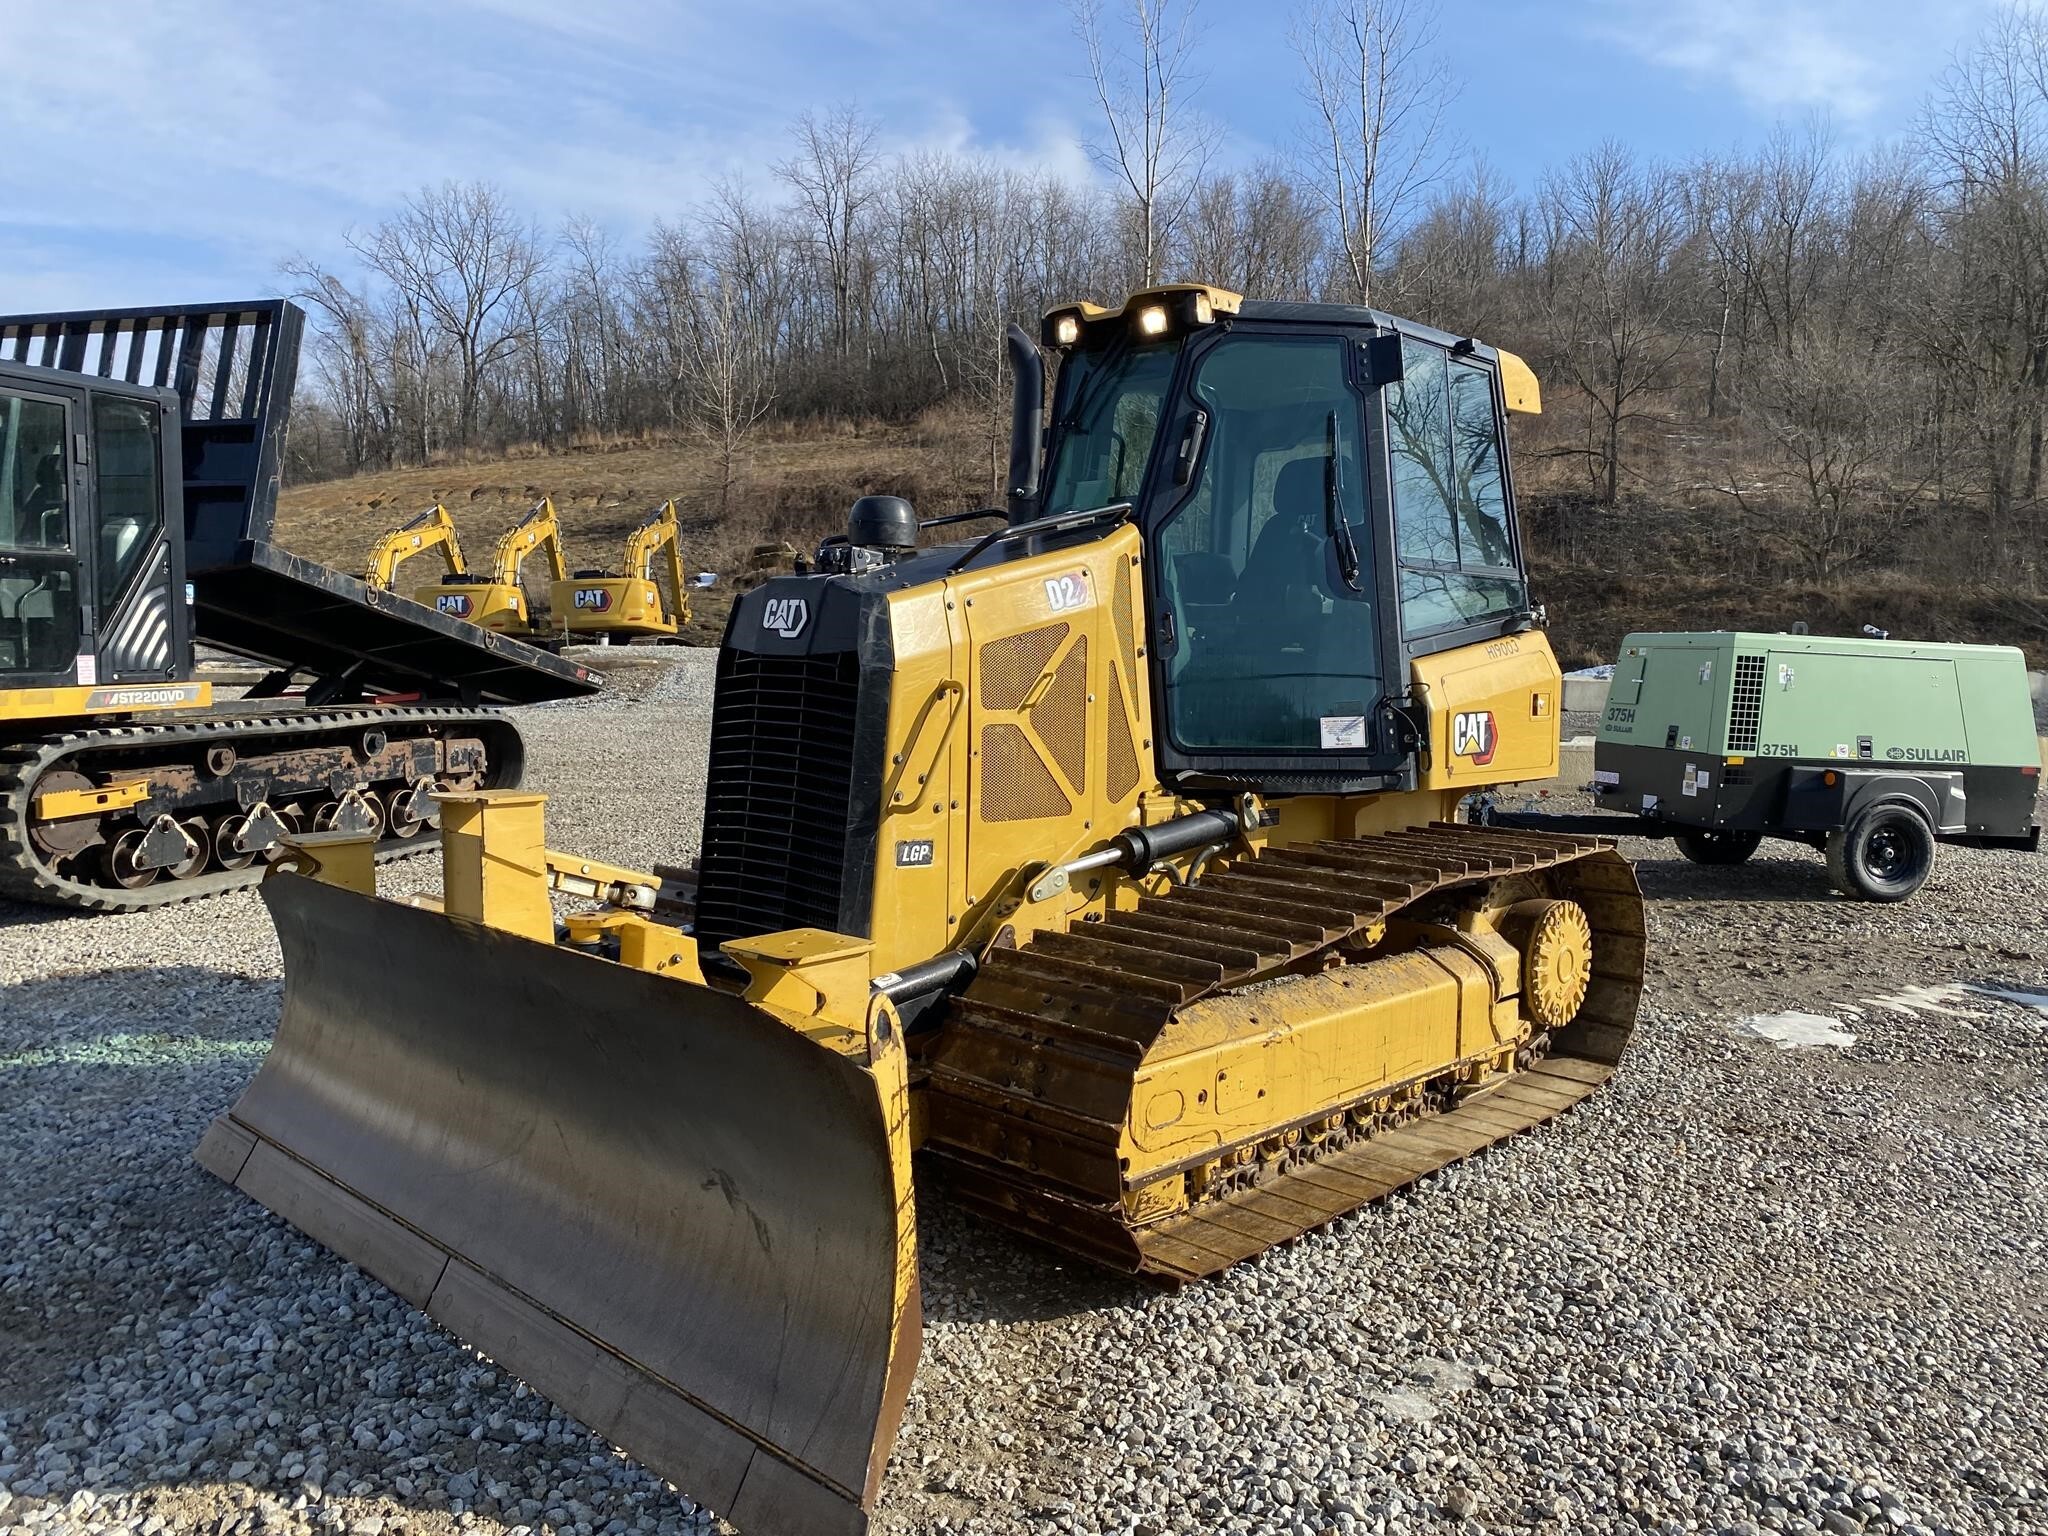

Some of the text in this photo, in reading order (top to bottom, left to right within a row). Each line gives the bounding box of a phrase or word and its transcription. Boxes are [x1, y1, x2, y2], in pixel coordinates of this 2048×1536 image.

[574, 590, 603, 608] CAT
[1045, 576, 1080, 610] D2
[436, 595, 465, 613] CAT
[763, 598, 800, 628] CAT
[1608, 707, 1636, 723] 375H
[1454, 712, 1489, 755] CAT
[1762, 744, 1799, 756] 375H
[1906, 748, 1966, 761] SULLAIR
[902, 845, 929, 861] LGP
